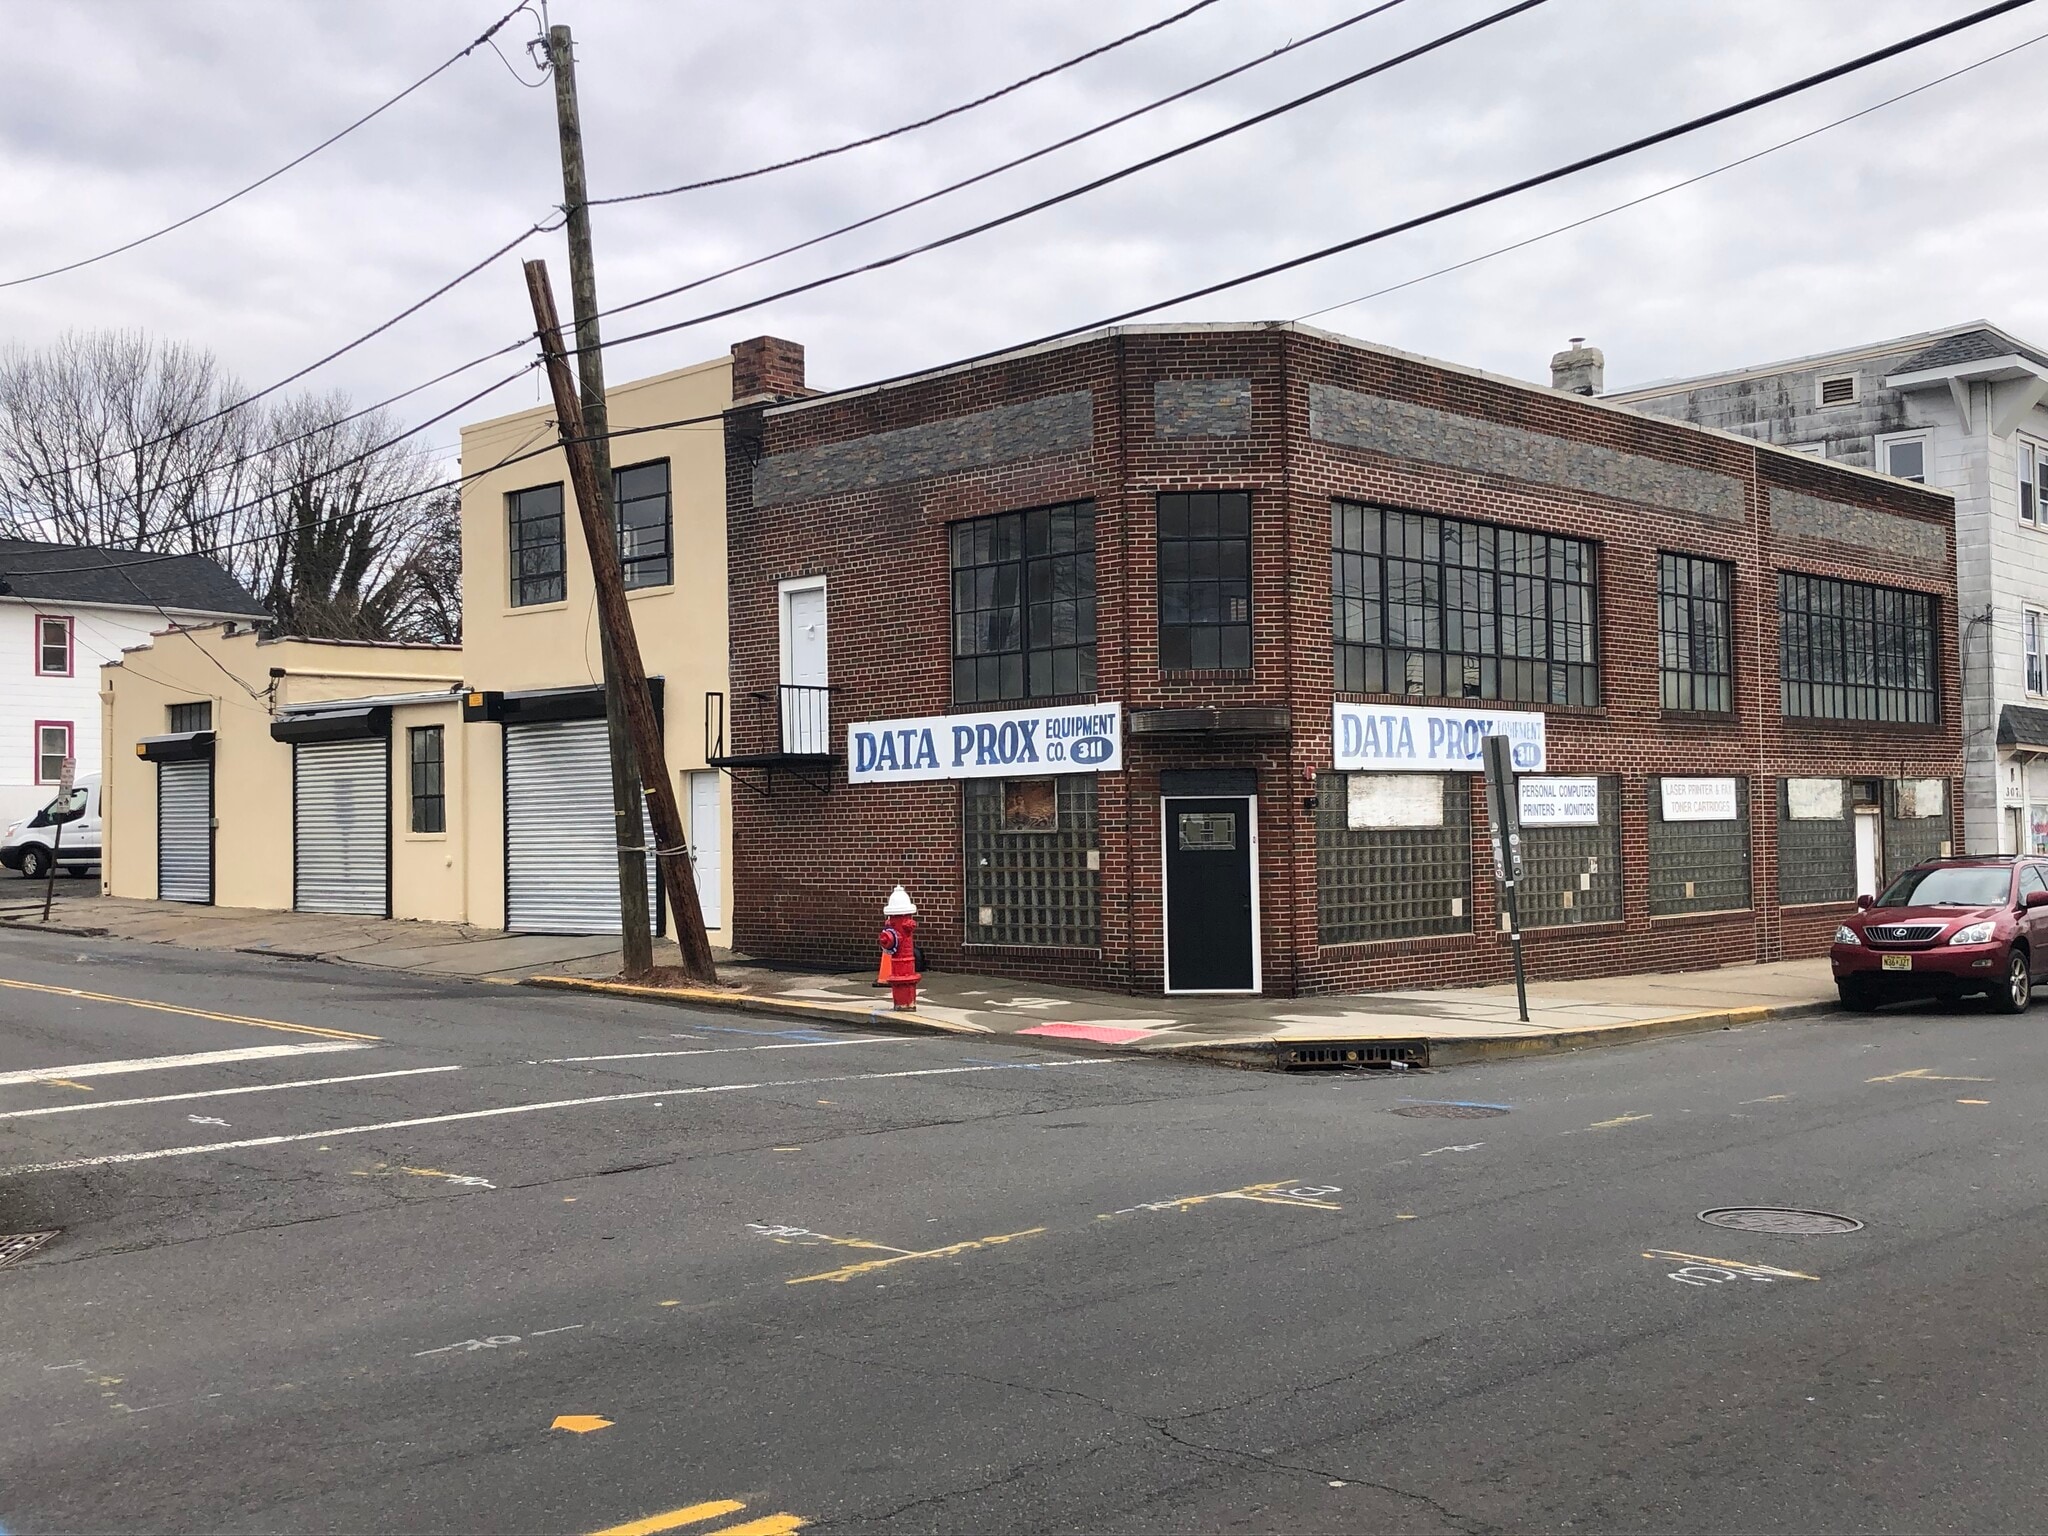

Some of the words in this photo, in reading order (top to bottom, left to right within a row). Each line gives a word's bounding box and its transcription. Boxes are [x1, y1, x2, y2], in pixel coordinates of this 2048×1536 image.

[1045, 713, 1116, 739] EQUIPMENT
[855, 727, 940, 773] DATA
[952, 719, 1040, 767] PROX
[1341, 714, 1417, 758] DATA
[1428, 717, 1493, 760] PROX
[1046, 741, 1067, 762] CO.
[1078, 740, 1103, 759] 311
[1517, 745, 1535, 763] 311
[1522, 784, 1557, 798] PERSONAL
[1559, 784, 1596, 798] COMPUTERS
[1666, 784, 1686, 795] LASER
[1688, 784, 1714, 796] PRINTER
[1523, 803, 1555, 817] PRINTERS
[1564, 803, 1595, 816] MONITORS
[1672, 801, 1692, 813] TONER
[1693, 801, 1730, 812] CARTRIDGES
